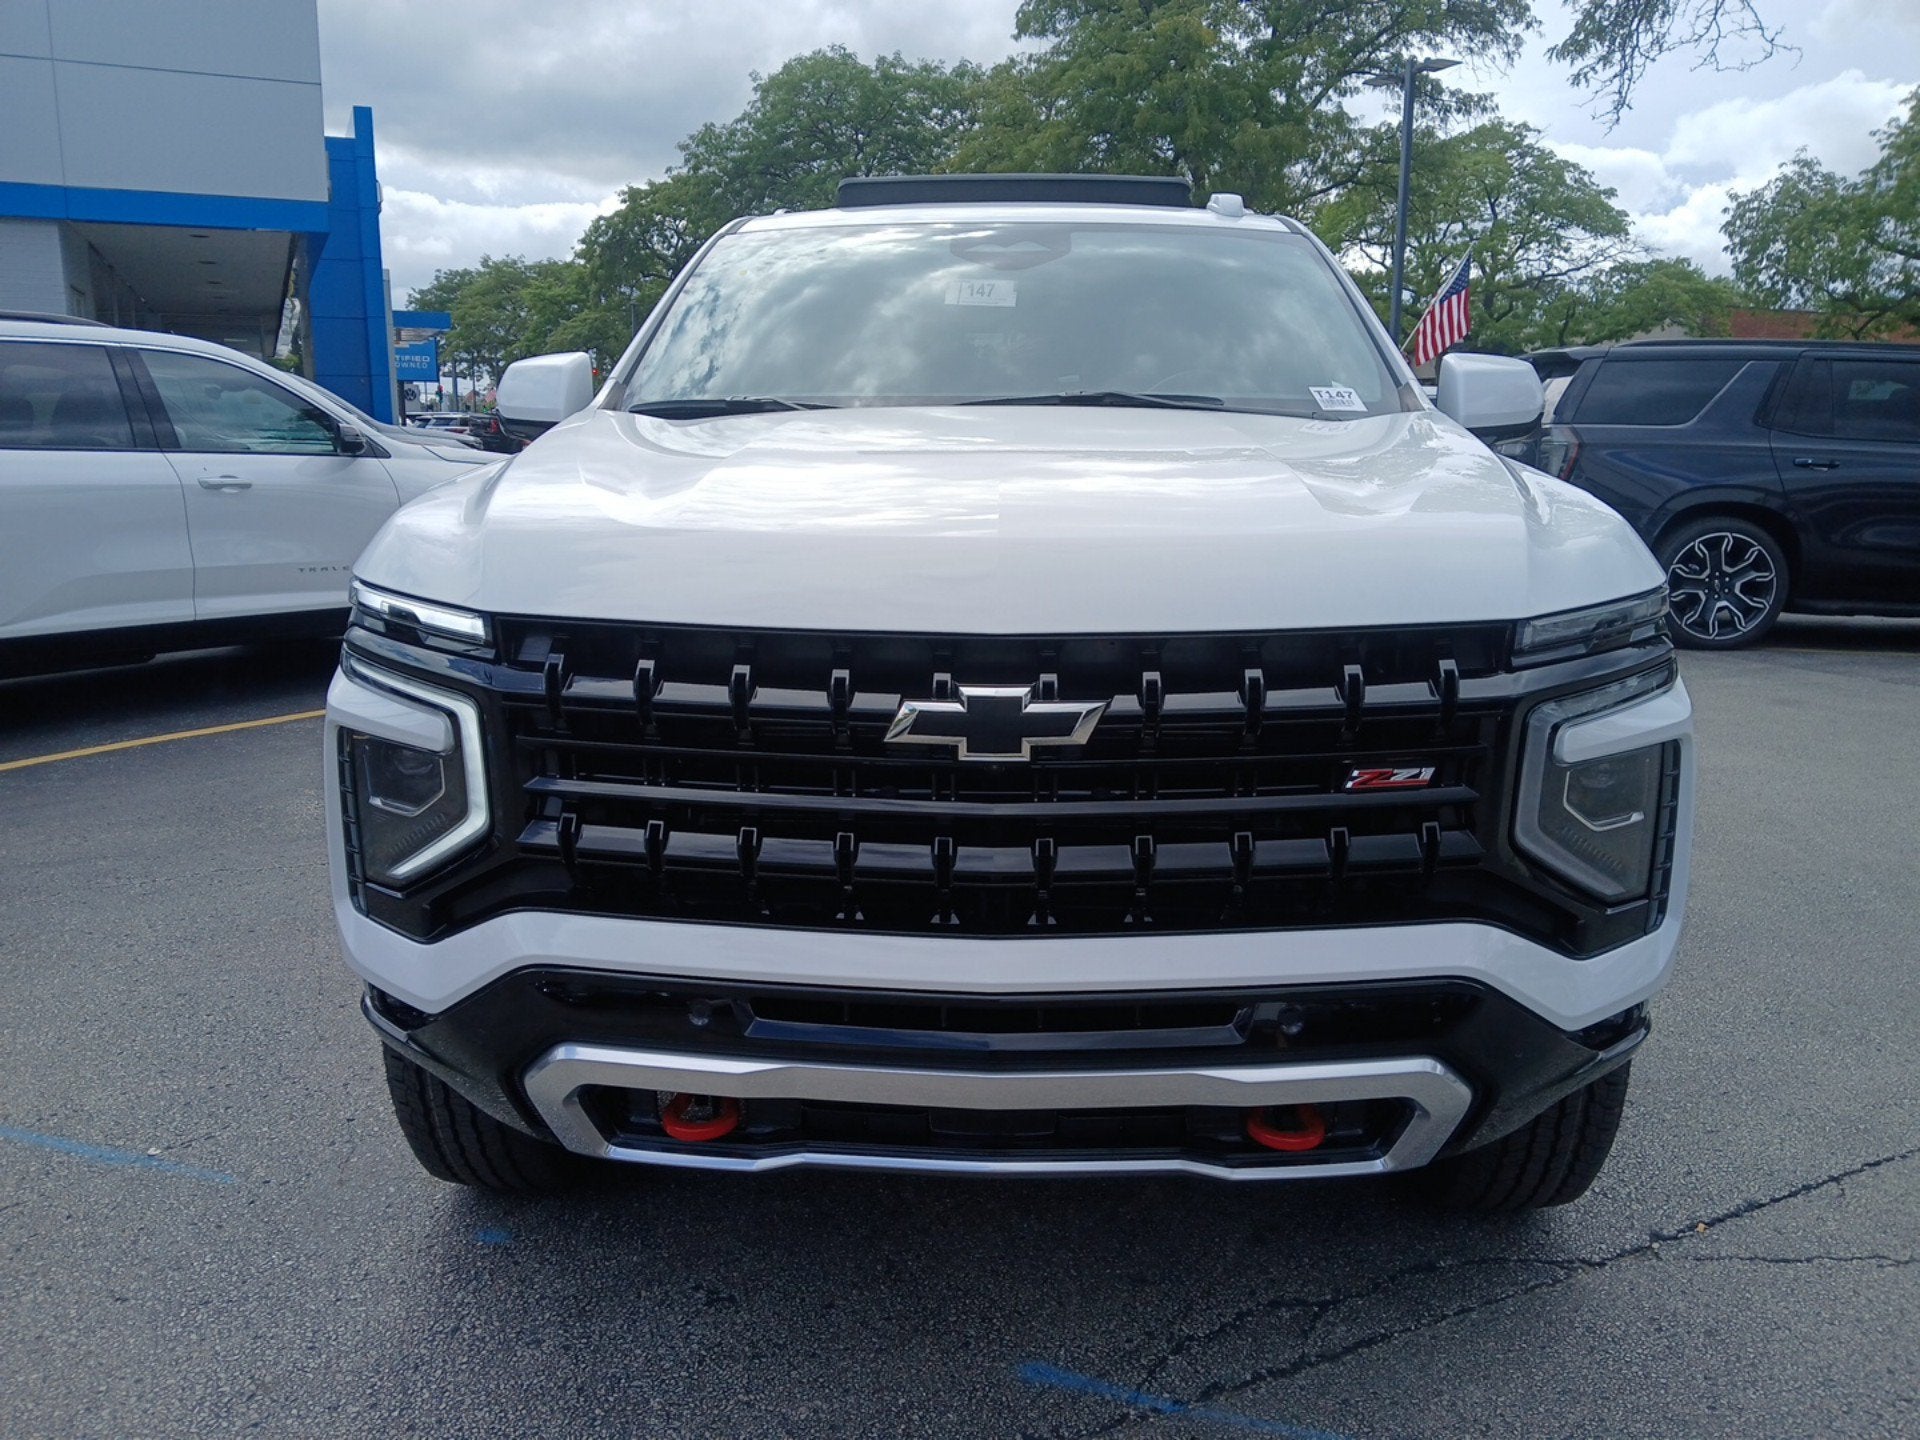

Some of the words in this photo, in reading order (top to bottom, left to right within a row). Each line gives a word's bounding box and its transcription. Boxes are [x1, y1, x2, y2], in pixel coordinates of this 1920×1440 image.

[968, 282, 996, 297] 147
[1313, 390, 1353, 399] T147
[1345, 767, 1435, 788] Z71
